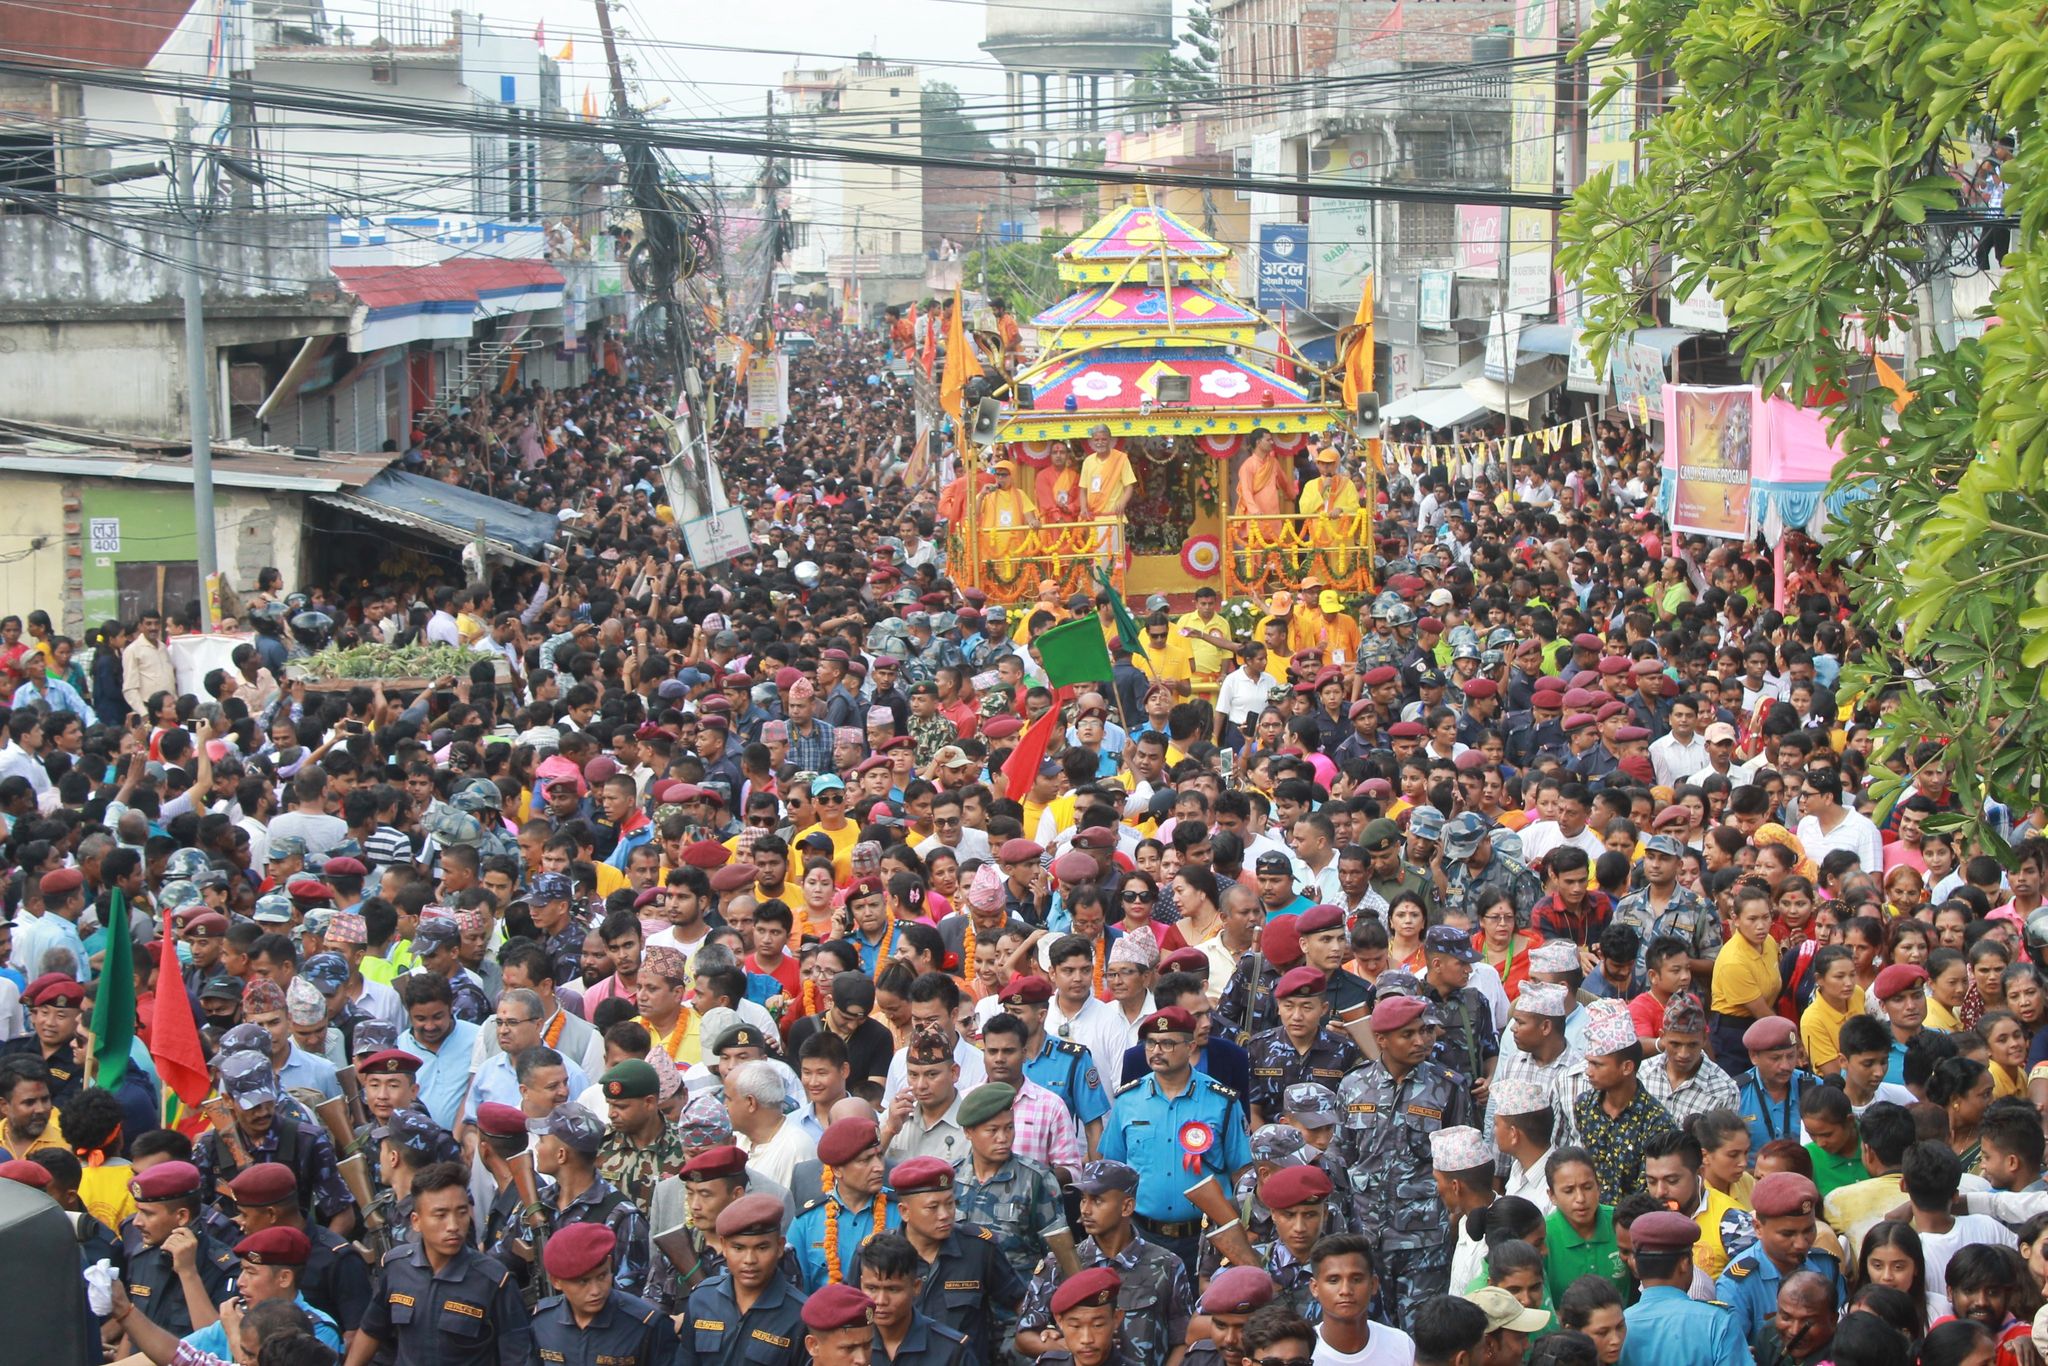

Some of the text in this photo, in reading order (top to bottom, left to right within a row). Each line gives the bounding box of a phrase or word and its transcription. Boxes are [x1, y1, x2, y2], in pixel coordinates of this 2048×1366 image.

[1262, 262, 1305, 277] अटल
[1680, 465, 1748, 484] CANDY SERVING PROGRAM
[94, 540, 118, 551] 400
